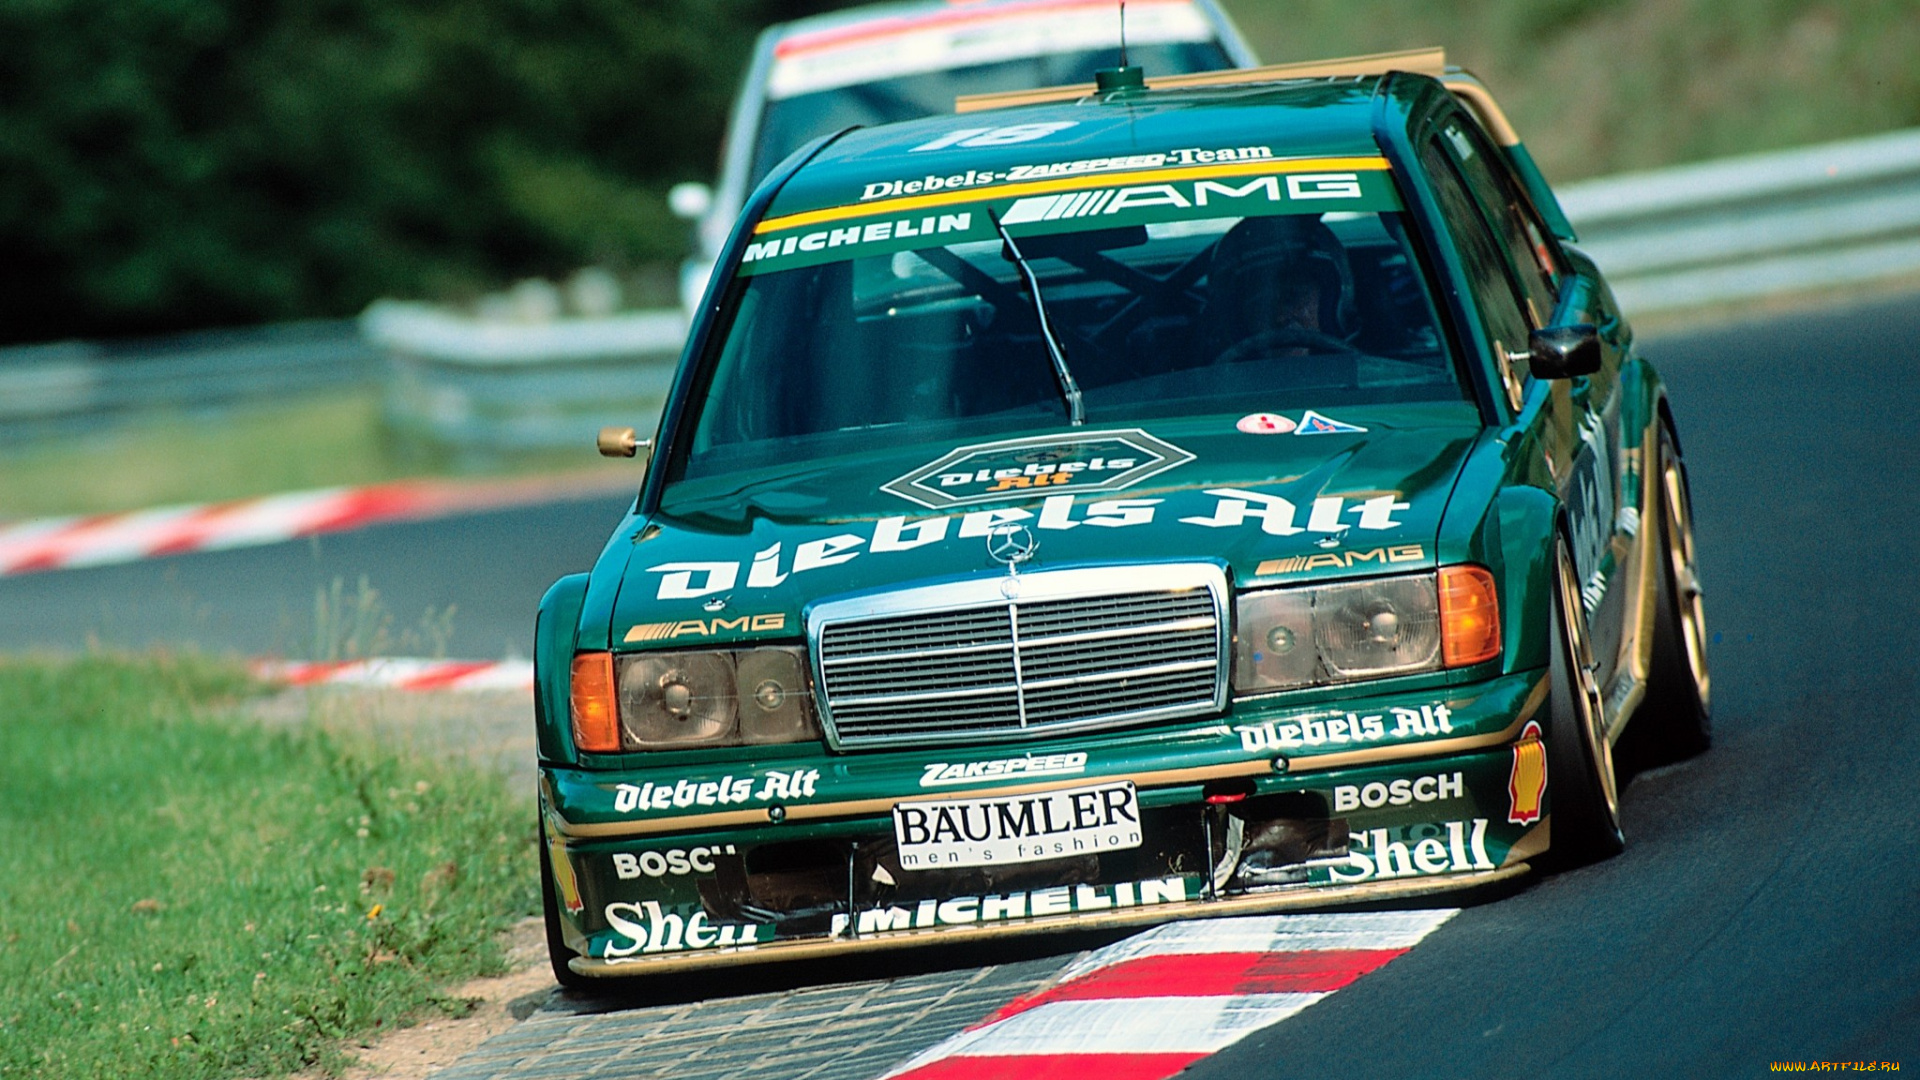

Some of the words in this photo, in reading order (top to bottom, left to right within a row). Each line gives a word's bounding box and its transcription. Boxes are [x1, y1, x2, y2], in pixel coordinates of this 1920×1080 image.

[1102, 172, 1362, 217] AMG
[742, 212, 972, 263] MICHELIN
[984, 471, 1074, 492] Alt
[645, 495, 1165, 601] Diebels
[1178, 488, 1410, 537] Alt
[1301, 544, 1424, 571] AMG
[670, 612, 786, 638] AMG
[1236, 712, 1384, 753] Diebels
[1389, 703, 1454, 738] Alt
[613, 775, 755, 813] Diebels
[755, 768, 821, 801] Alt
[919, 752, 1088, 788] ZAKSPEED
[1334, 771, 1464, 812] BOSCH
[899, 786, 1138, 847] BÄUMLER
[902, 846, 995, 866] men's
[1018, 830, 1141, 858] fashion
[1329, 818, 1496, 884] Shell
[857, 877, 1188, 934] MICHELIN
